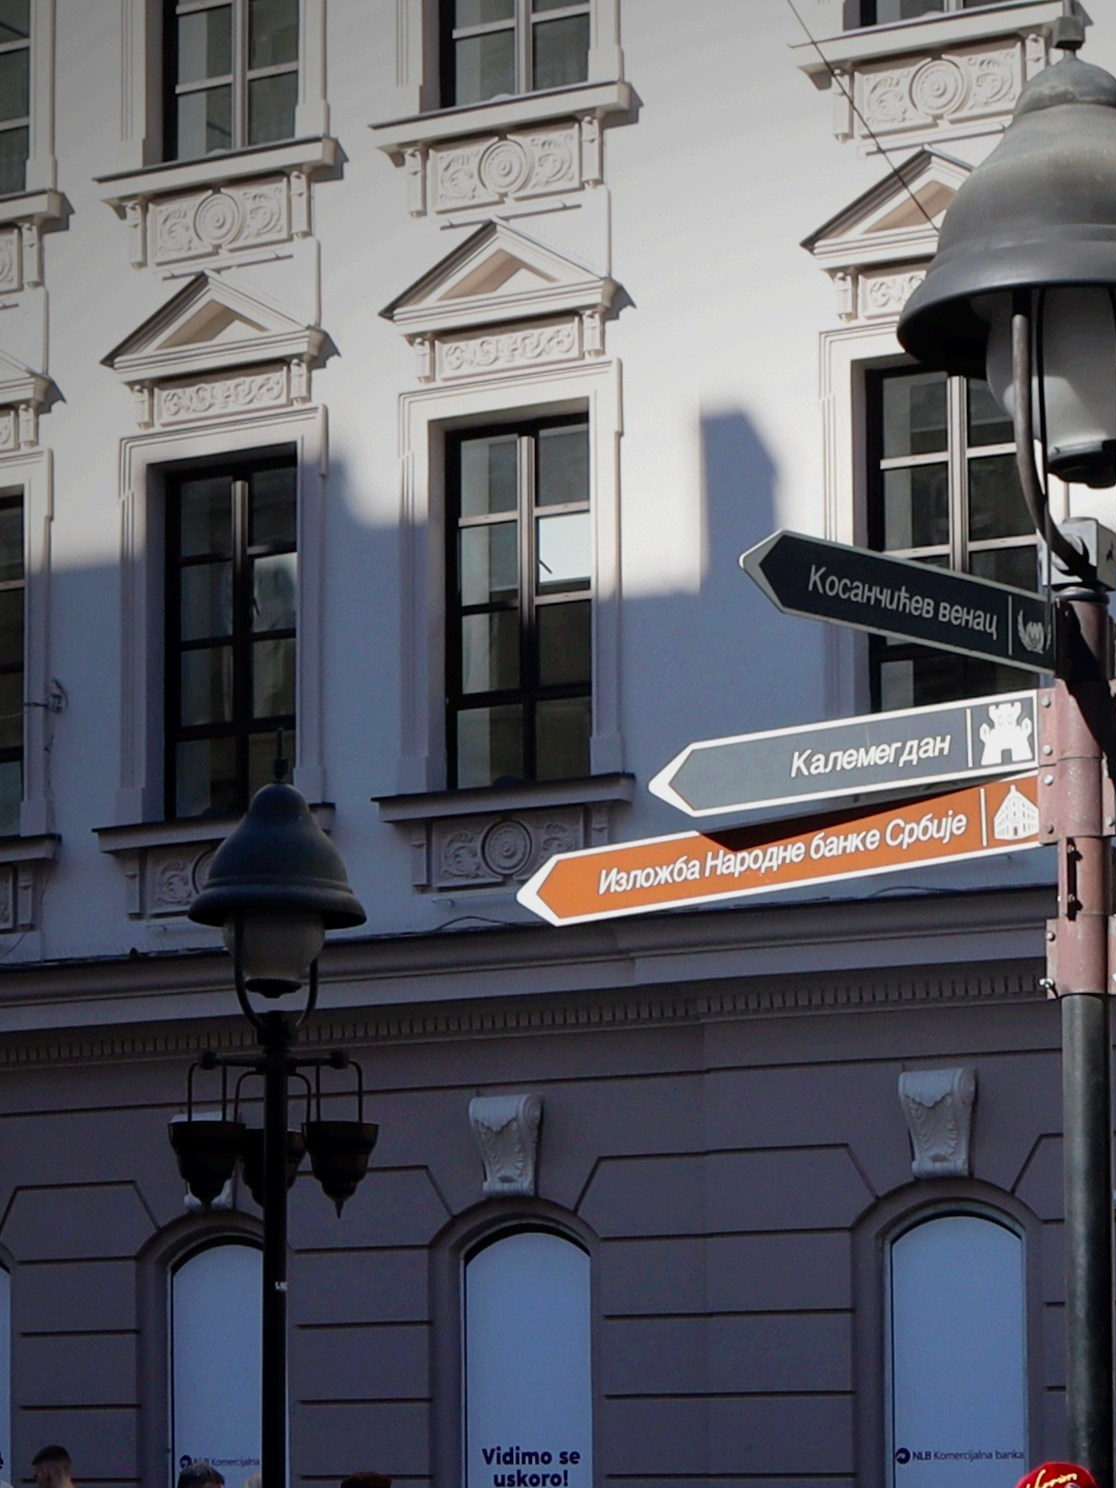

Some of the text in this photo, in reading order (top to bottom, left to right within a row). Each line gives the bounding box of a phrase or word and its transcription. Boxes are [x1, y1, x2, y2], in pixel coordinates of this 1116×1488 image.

[808, 565, 998, 641] Косанчићев венац
[790, 735, 951, 778] Калемегдан
[598, 809, 968, 896] Изложба Народне банке Србије
[481, 1446, 581, 1466] Vidimo se
[912, 1448, 1026, 1463] NLB Komercijalna banka
[493, 1469, 569, 1488] uskoro!
